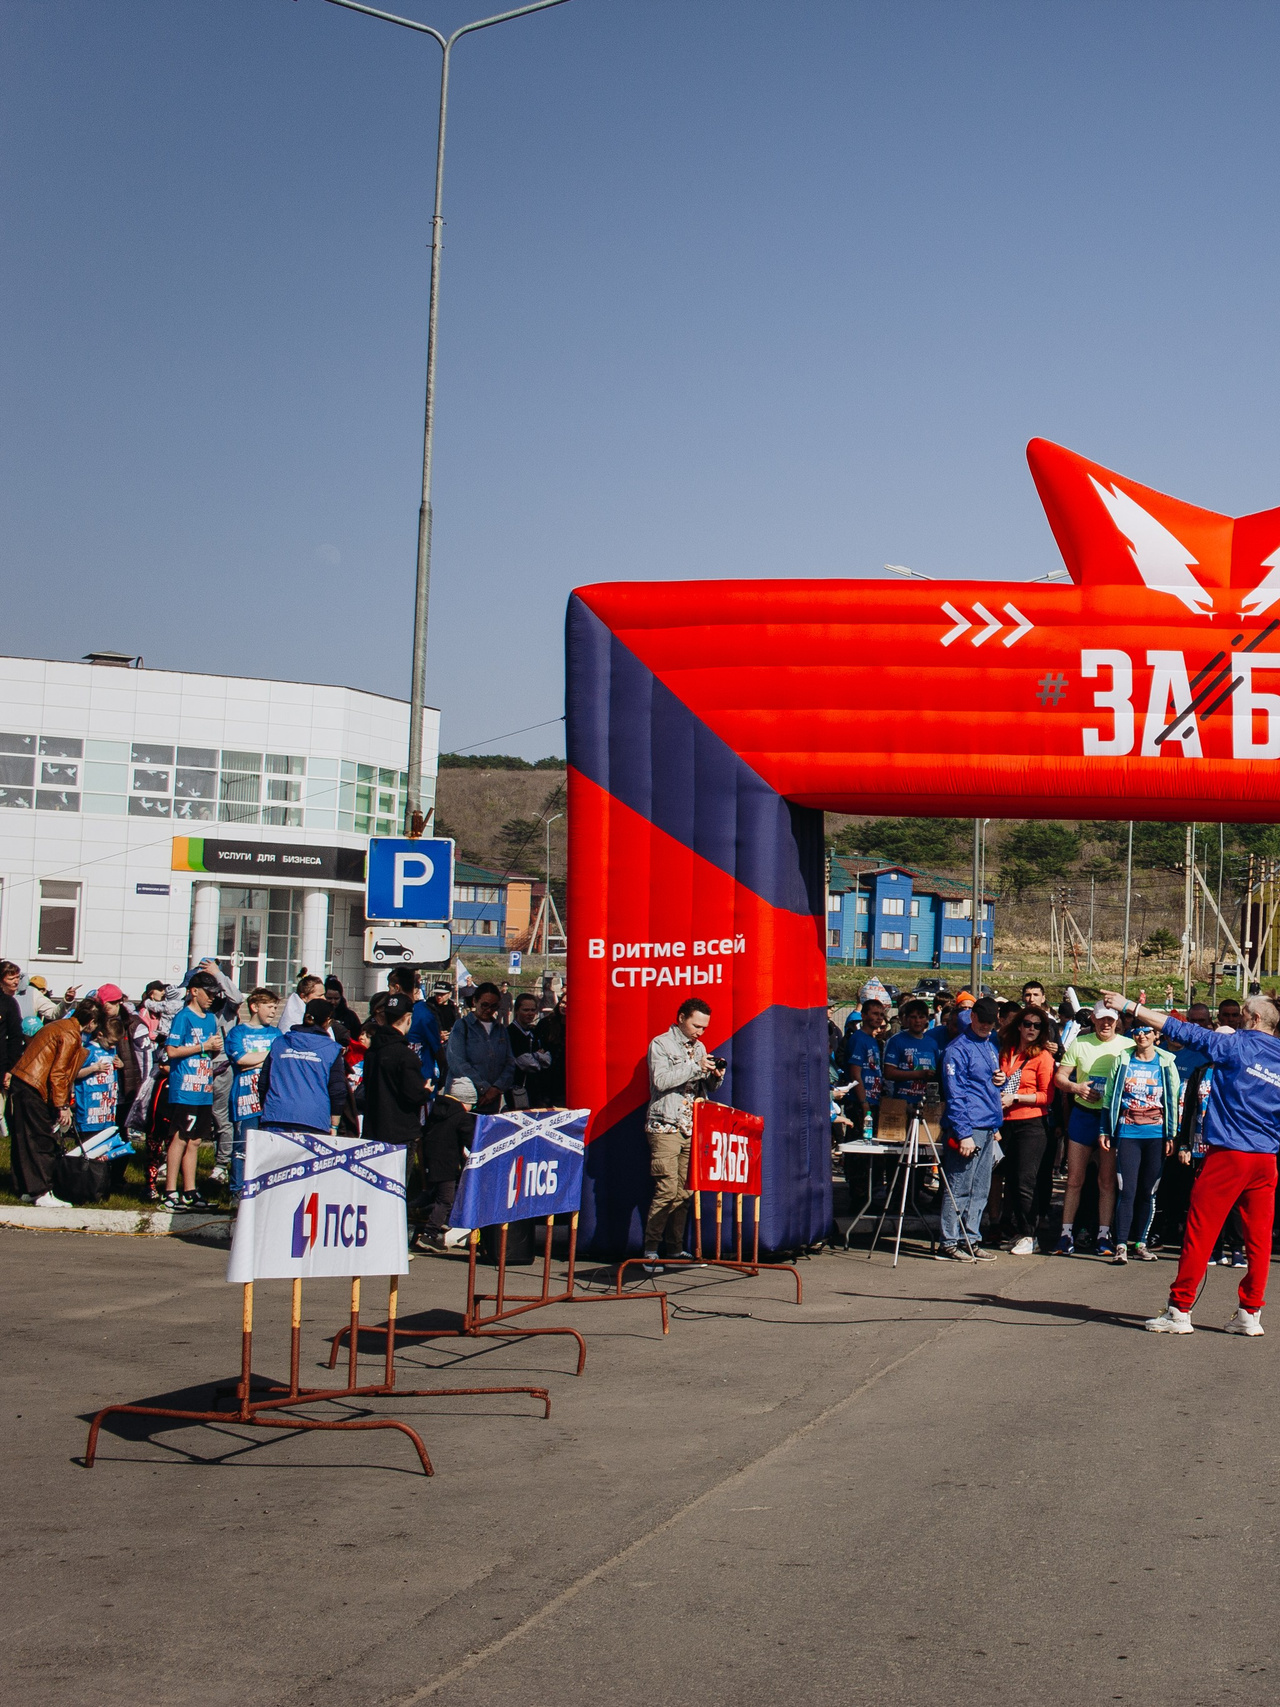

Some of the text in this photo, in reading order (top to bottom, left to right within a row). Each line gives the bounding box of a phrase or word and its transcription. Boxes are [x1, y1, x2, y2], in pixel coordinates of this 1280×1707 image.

[218, 851, 322, 865] УСЛУГИ ДЛЯ БИЗНЕСА
[394, 852, 435, 908] P
[588, 933, 746, 962] В ритме всей
[611, 963, 723, 988] СТРАНЫ!
[186, 1115, 197, 1132] 7
[267, 1165, 305, 1186] ЗАБЕГ.РФ
[312, 1153, 348, 1172] ЗАБЕГ.РФ
[354, 1142, 386, 1160] ЗАБЕГ.РФ
[524, 1160, 559, 1198] ПСБ
[323, 1203, 368, 1249] ПСБ
